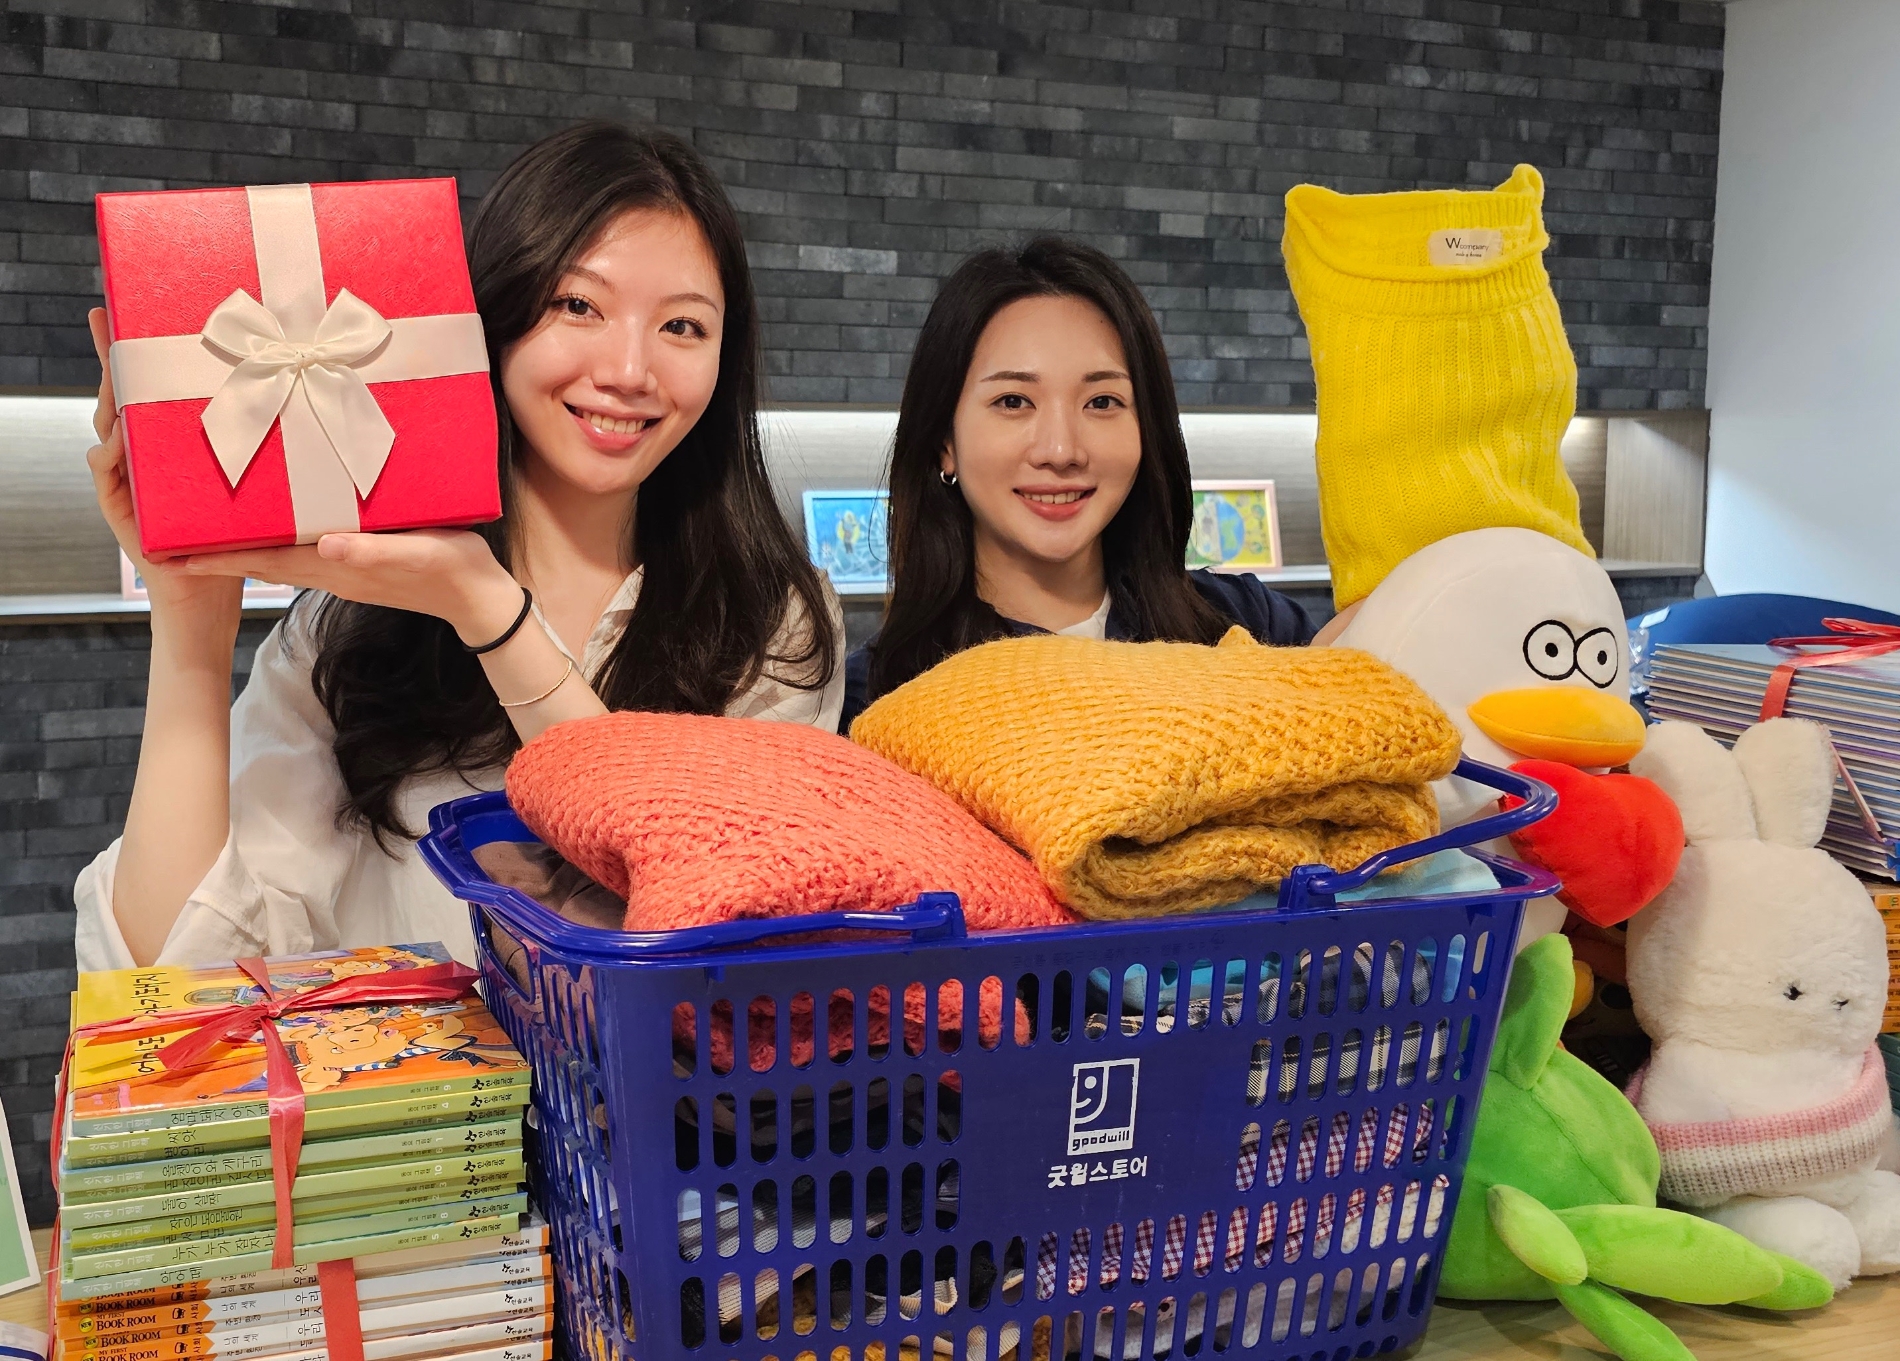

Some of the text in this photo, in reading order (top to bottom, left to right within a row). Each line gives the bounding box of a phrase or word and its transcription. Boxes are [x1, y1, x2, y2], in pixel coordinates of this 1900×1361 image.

[485, 1077, 515, 1087] 한솔교육
[483, 1093, 513, 1103] 한솔교육
[171, 1107, 227, 1125] 엄마돼지
[93, 1118, 154, 1131] 신기한 그림책
[168, 1129, 197, 1144] 씨앗
[478, 1129, 507, 1139] 한솔교육
[1072, 1130, 1130, 1151] goodwill
[89, 1137, 150, 1151] 신기한 그림책
[162, 1155, 264, 1178] 올챙이와 개구리
[434, 1164, 443, 1176] 10
[477, 1159, 506, 1169] 한솔교육
[83, 1171, 144, 1185] 신기한 그림책
[1047, 1155, 1148, 1190] 굿윌스토어
[162, 1192, 222, 1212] 둘이 살짝
[481, 1203, 510, 1213] 한솔교육
[83, 1205, 144, 1220] 신기한 그림책
[473, 1224, 502, 1234] 한솔교육
[172, 1245, 200, 1260] 누가
[204, 1240, 232, 1256] 누가
[94, 1254, 155, 1270] 신기한 그림책
[82, 1282, 112, 1294] 신기한
[115, 1278, 143, 1289] 그림책
[295, 1290, 321, 1305] 우리
[96, 1297, 155, 1313] BOOK ROOM
[222, 1299, 258, 1312] 나의 세계
[81, 1321, 92, 1329] NEW
[96, 1315, 156, 1331] BOOK ROOM
[298, 1322, 324, 1337] 우리
[85, 1338, 97, 1346] NEW
[101, 1334, 130, 1347] BOOK
[132, 1330, 161, 1343] ROOM
[223, 1333, 259, 1346] 나의 세계
[129, 1350, 159, 1361] ROOM
